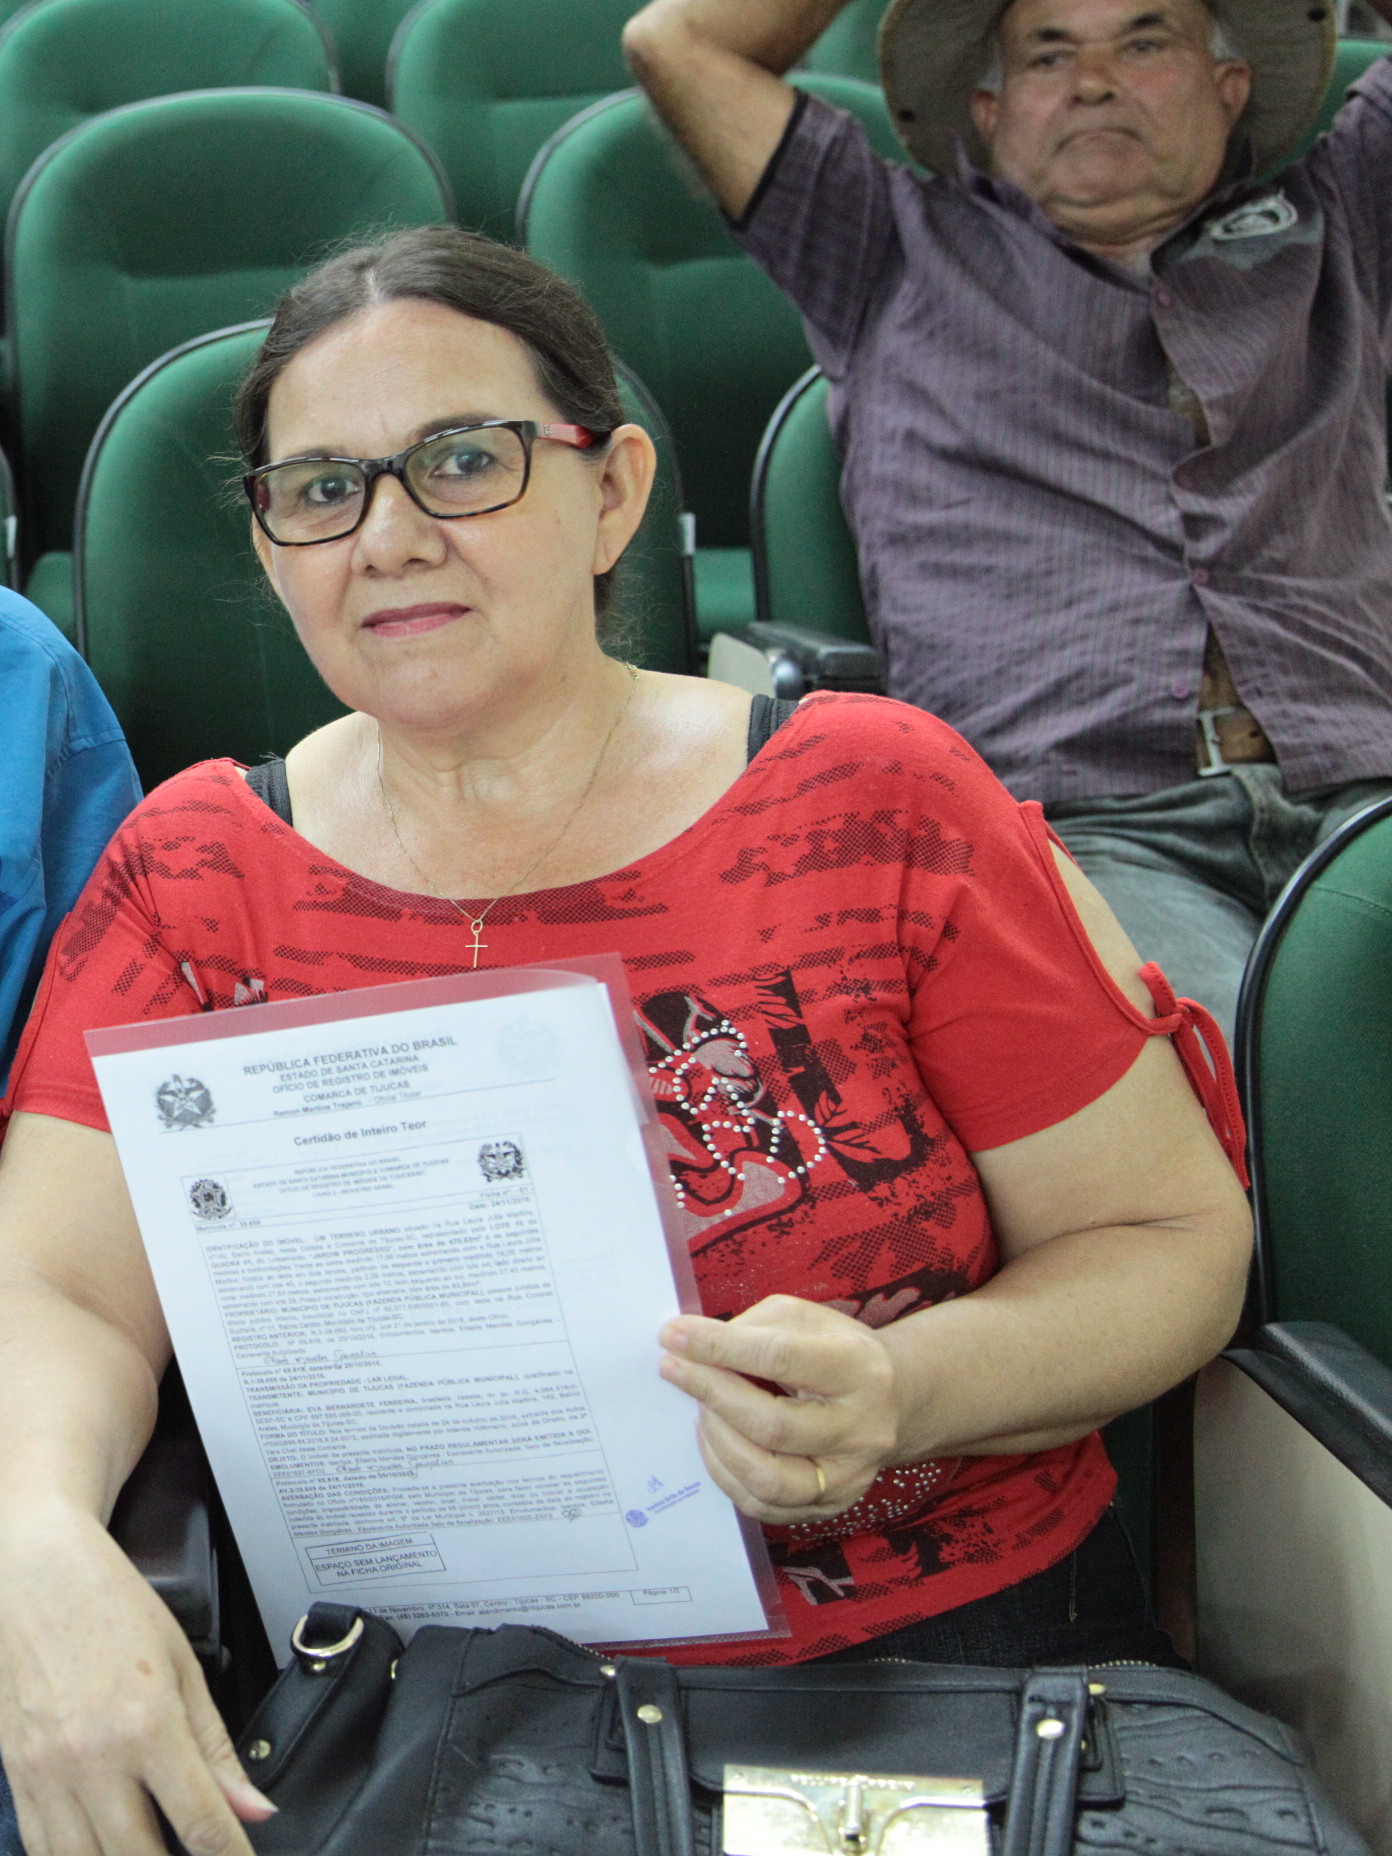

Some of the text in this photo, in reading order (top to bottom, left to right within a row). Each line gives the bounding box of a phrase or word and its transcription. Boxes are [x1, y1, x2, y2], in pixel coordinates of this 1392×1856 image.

[241, 1035, 458, 1076] REPÚBLICA FEDERATIVA DO BRASIL
[279, 1054, 419, 1081] ESTADO DE SANTA CATARINA
[271, 1062, 428, 1094] OFÍCIO DE REGISTRO DE IMÓVEIS
[303, 1080, 410, 1102] COMARCA DE TIJUCAS
[293, 1119, 427, 1146] Certidão de Inteiro Teor
[325, 1544, 364, 1554] TÉRMINO
[378, 1537, 413, 1547] IMAGEM
[315, 1549, 437, 1571] ESPAÇO SEM LANÇAMENTO
[350, 1566, 379, 1575] FICHA
[379, 1560, 422, 1571] ORIGINAL
